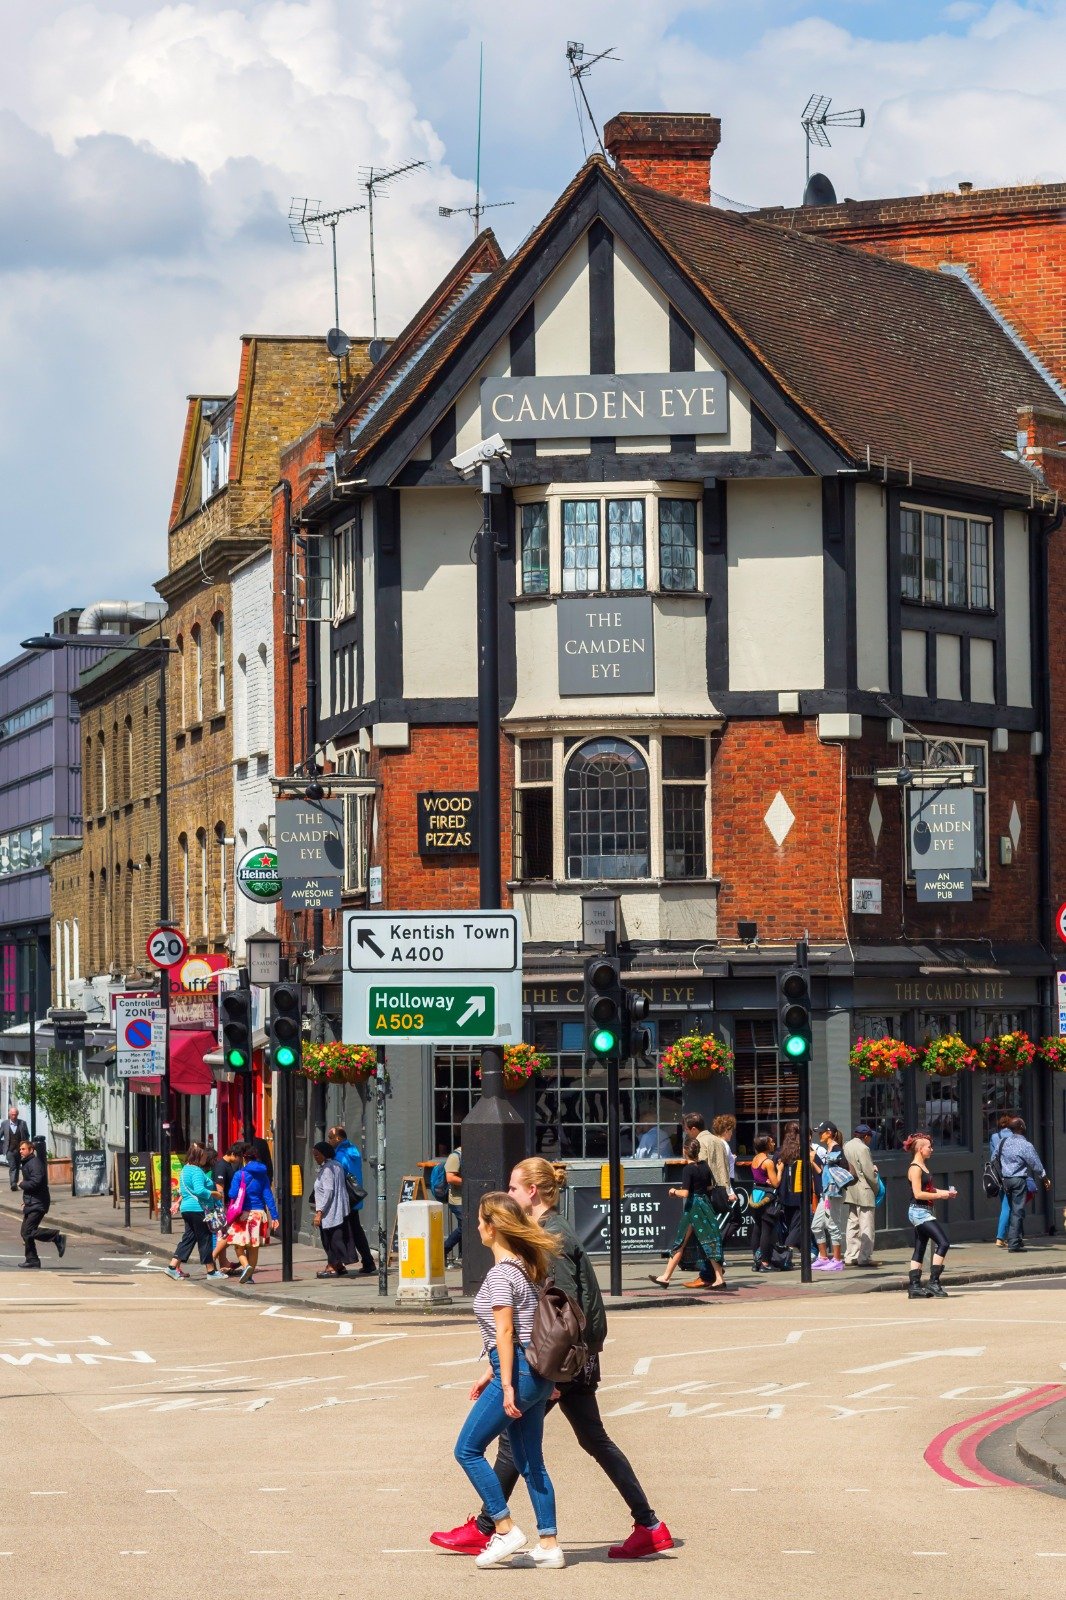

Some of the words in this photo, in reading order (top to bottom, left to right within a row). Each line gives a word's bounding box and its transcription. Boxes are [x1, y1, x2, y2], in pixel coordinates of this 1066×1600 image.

[491, 390, 646, 422] CAMDEN
[660, 387, 716, 418] EYE
[585, 612, 622, 628] THE
[564, 638, 645, 655] CAMDEN
[591, 663, 621, 678] EYE
[423, 797, 472, 811] WOOD
[931, 803, 956, 815] THE
[296, 813, 323, 825] THE
[429, 815, 466, 829] FIRED
[915, 821, 971, 833] CAMDEN
[280, 830, 339, 843] CAMDEN
[425, 832, 472, 847] PIZZAS
[933, 839, 955, 851] EYE
[300, 848, 322, 860] EYE
[937, 872, 950, 880] AN
[305, 880, 319, 889] AN
[924, 881, 965, 890] AWESOME
[291, 889, 334, 898] AWESOME
[937, 891, 953, 899] PUB
[304, 899, 321, 907] PUB
[390, 924, 455, 940] Kentish
[463, 924, 510, 939] Town
[152, 939, 182, 958] 20
[391, 947, 444, 962] A400
[522, 988, 559, 1003] THE
[662, 987, 695, 1002] EYE
[895, 983, 920, 1000] THE
[926, 983, 979, 1000] CAMDEN
[985, 982, 1004, 999] EYE
[375, 992, 455, 1011] Holloway
[375, 1014, 425, 1030] A503
[630, 1202, 661, 1212] BEST
[638, 1214, 653, 1224] IN
[600, 1400, 911, 1420] WAY
